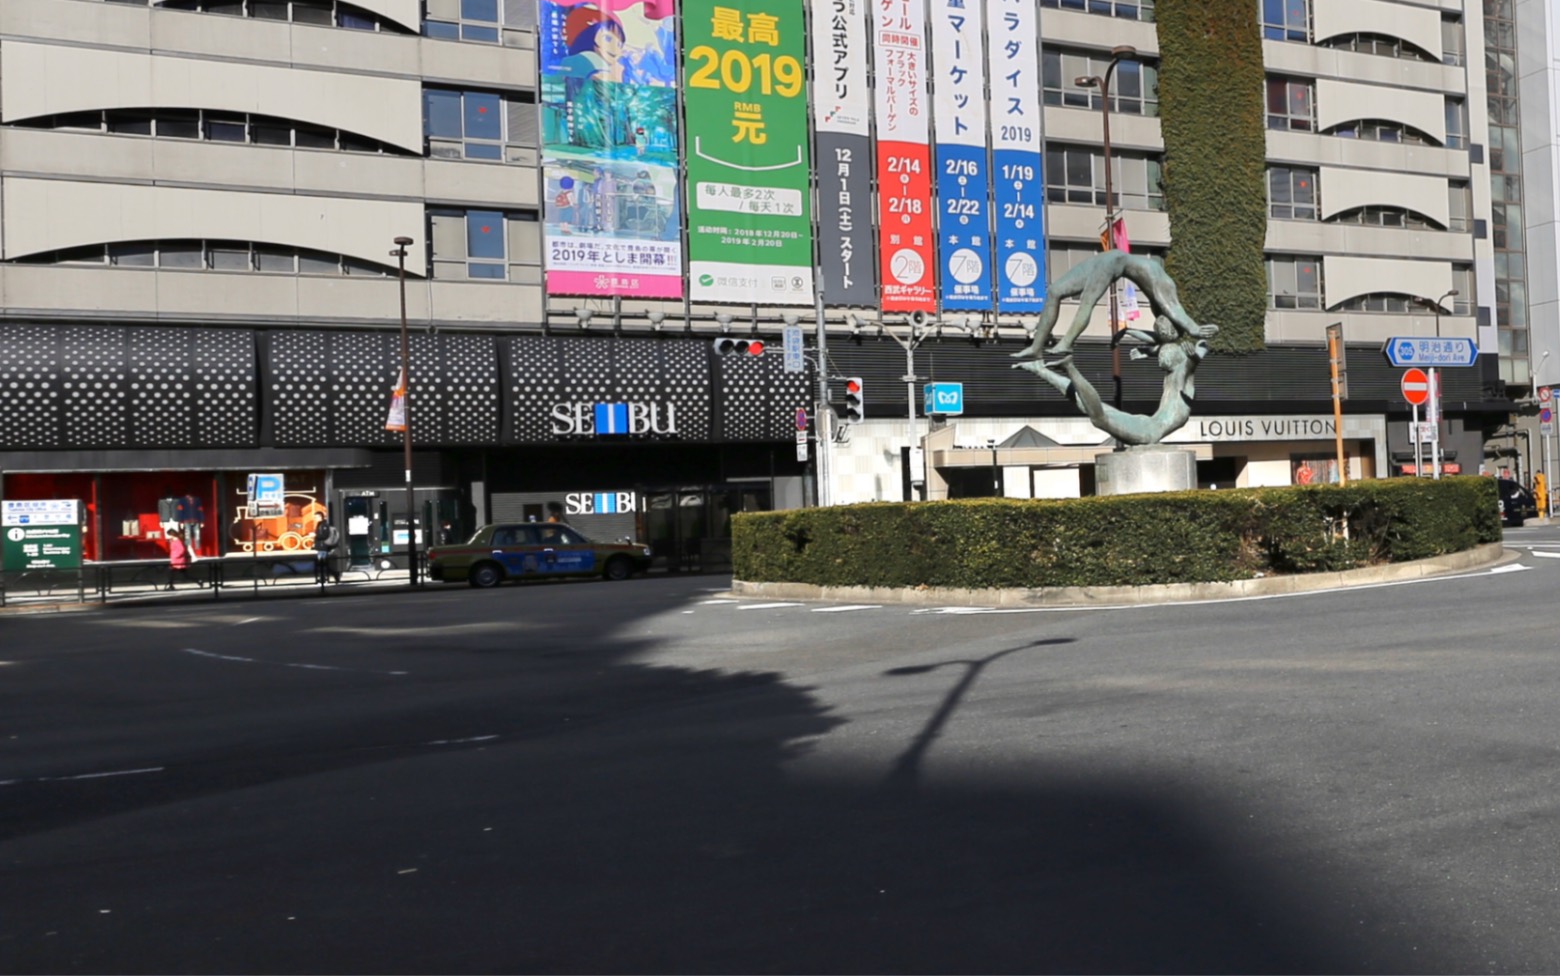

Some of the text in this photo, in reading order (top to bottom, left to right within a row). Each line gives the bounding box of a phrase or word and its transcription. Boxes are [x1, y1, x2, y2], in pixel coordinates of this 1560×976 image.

[711, 6, 779, 47] 最高
[881, 32, 919, 48] 同時開催
[689, 45, 802, 98] 2019
[896, 50, 906, 87] ブラック
[885, 49, 897, 132] フォーマルバーゲン
[906, 51, 919, 116] 大きいサイズの
[734, 101, 762, 113] RMB
[731, 111, 767, 145] 元
[1001, 125, 1032, 142] 2019
[888, 157, 921, 174] 2/14
[946, 159, 978, 175] 2/16
[1002, 165, 1034, 181] 1/19
[889, 197, 922, 214] 2/18
[947, 199, 980, 215] 2/22
[1004, 203, 1034, 219] 2/14
[895, 255, 922, 279] 2階
[952, 256, 980, 278] 7階
[1009, 259, 1035, 281] 7階
[1418, 340, 1465, 353] 明治通り
[552, 401, 679, 435] SEIBU
[1200, 419, 1337, 438] LOUIS VUITTON
